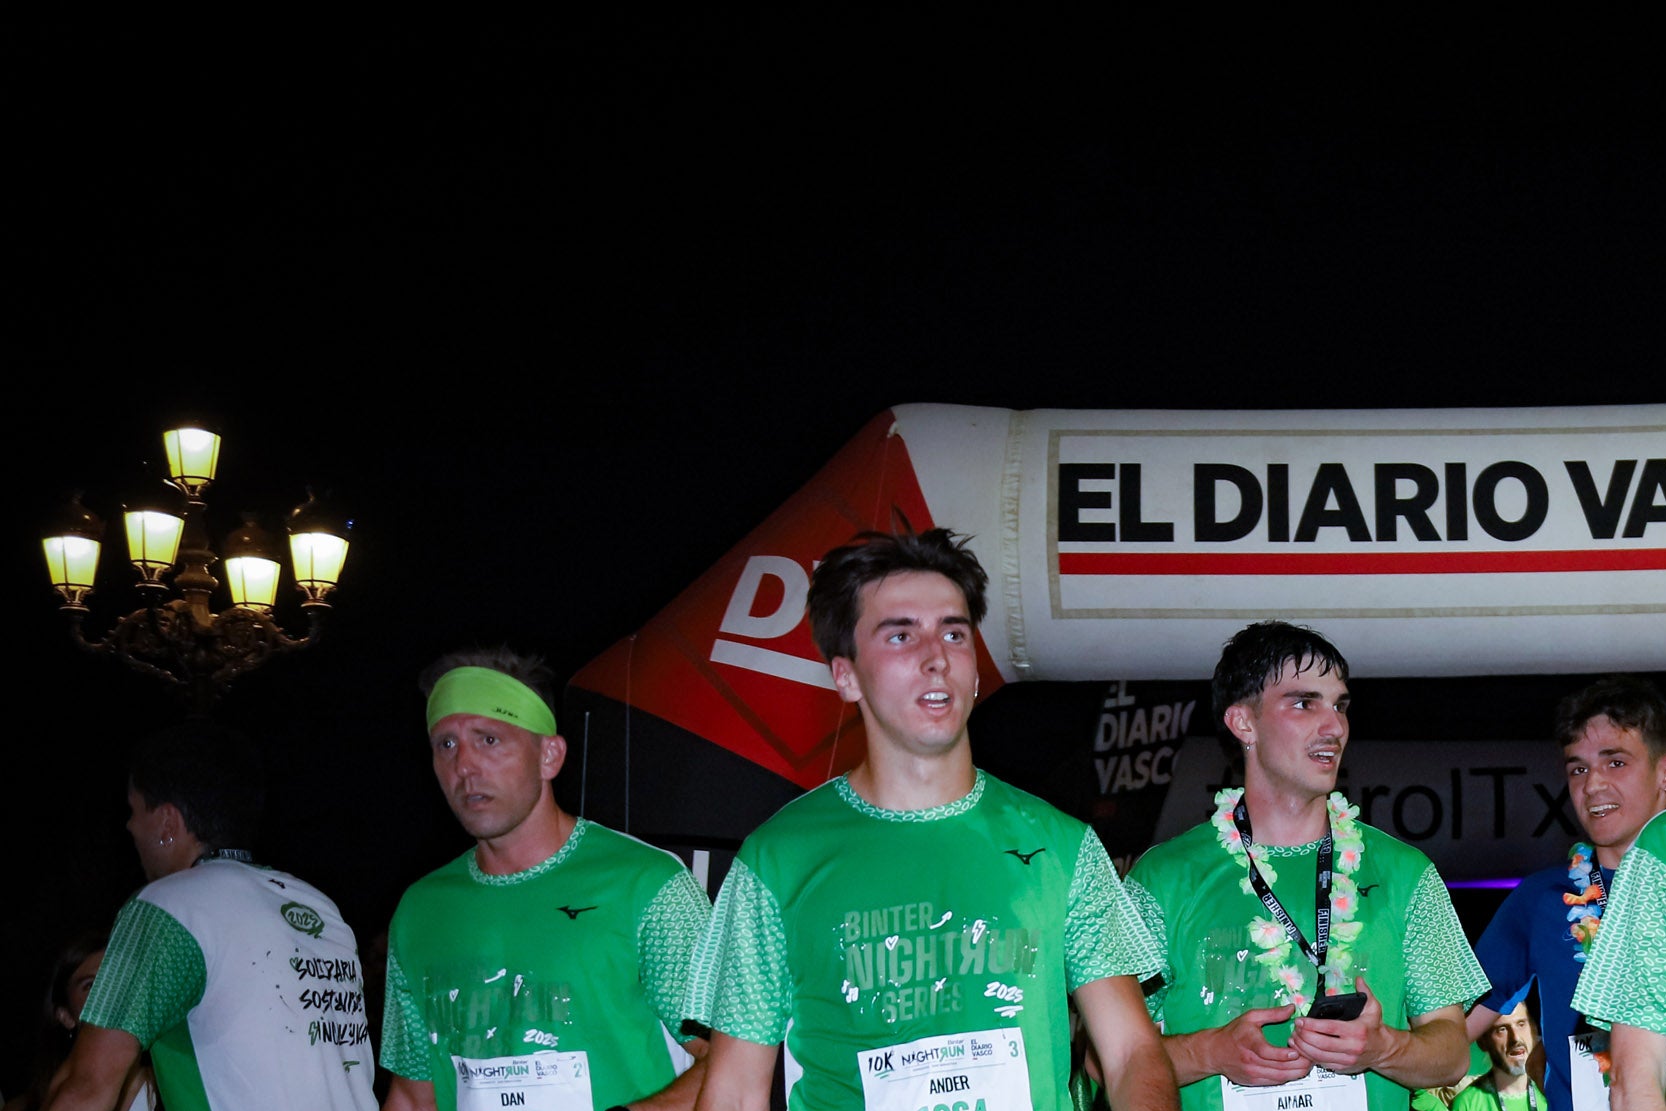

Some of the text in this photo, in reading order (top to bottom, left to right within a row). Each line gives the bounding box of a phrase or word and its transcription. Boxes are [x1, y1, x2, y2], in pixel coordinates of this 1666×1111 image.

[1058, 462, 1175, 543] EL
[1192, 459, 1550, 543] DIARIO
[718, 555, 822, 639] D
[1094, 747, 1180, 795] VASC
[844, 902, 934, 943] BINTER
[1261, 891, 1298, 935] FINISHER
[1317, 907, 1330, 954] FINISHER
[883, 981, 964, 1022] SERIES
[983, 981, 1024, 1003] 2025
[523, 1028, 560, 1048] 2025
[1008, 1040, 1019, 1058] 3
[573, 1063, 583, 1078] 2
[867, 1051, 895, 1073] 10K
[928, 1074, 971, 1095] ANDER
[500, 1092, 526, 1107] DAN
[1277, 1093, 1313, 1110] AIMAR
